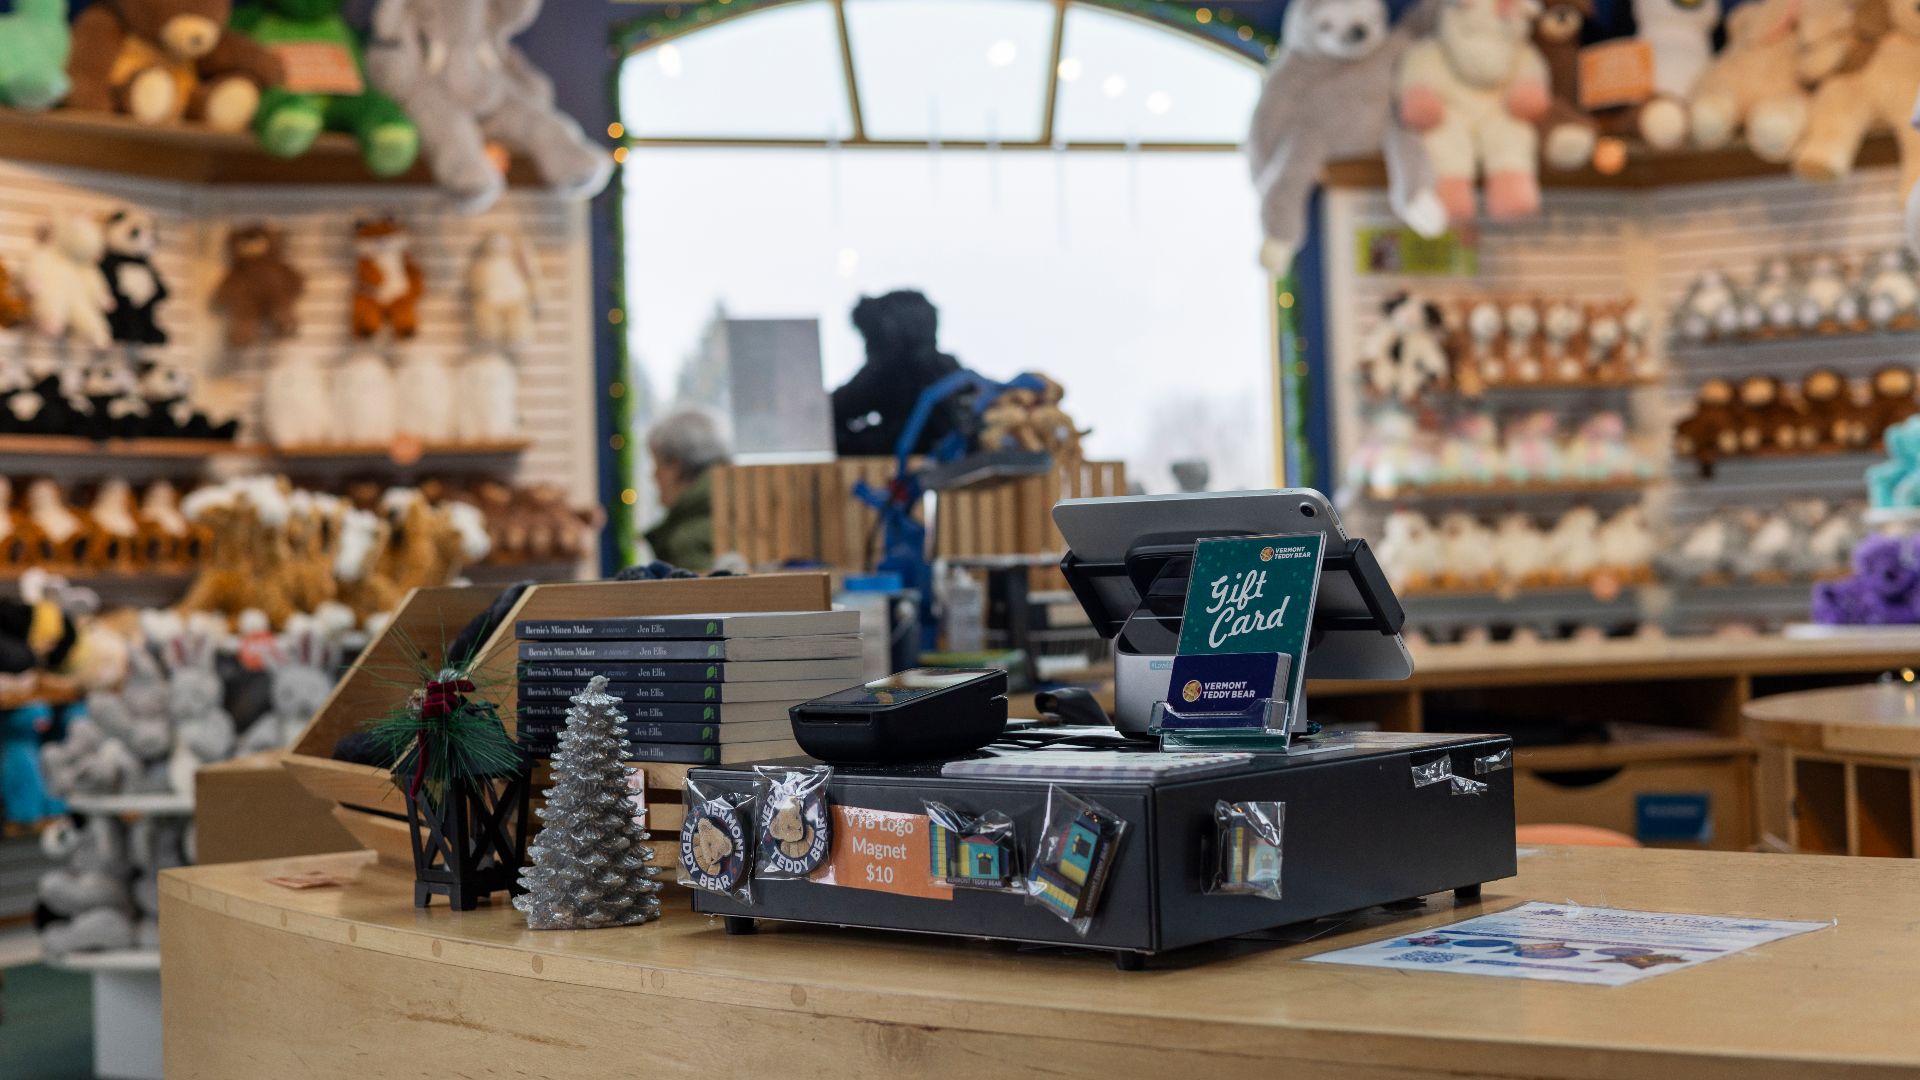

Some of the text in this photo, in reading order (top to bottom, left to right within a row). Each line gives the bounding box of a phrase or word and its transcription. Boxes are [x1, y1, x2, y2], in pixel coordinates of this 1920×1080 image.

[1206, 569, 1267, 613] Gift
[1208, 595, 1291, 649] Card
[525, 625, 550, 634] Bernie's
[550, 625, 572, 634] Mitten
[572, 625, 594, 634] Maker
[637, 624, 650, 633] Jen
[651, 624, 666, 633] Ellis
[528, 647, 552, 657] Bernie's
[553, 647, 574, 656] Mitten
[575, 647, 596, 656] Maker
[639, 647, 652, 656] Jen
[653, 647, 667, 656] Ellis
[527, 667, 551, 677] Bernie's
[552, 667, 573, 677] Mitten
[574, 668, 595, 677] Maker
[638, 668, 650, 677] Jen
[651, 667, 666, 677] Ellis
[1204, 681, 1248, 690] VERMONT
[552, 687, 573, 696] Mitten
[637, 688, 649, 697] Jen
[650, 688, 664, 697] Ellis
[1202, 690, 1256, 699] TEDDY BEAR
[636, 708, 648, 717] Jen
[649, 708, 663, 717] Ellis
[635, 727, 647, 736] Jen
[648, 727, 663, 736] Ellis
[636, 748, 649, 757] Jen
[649, 747, 664, 757] Ellis
[880, 816, 914, 837] Logo
[702, 802, 744, 862] VERMONT
[771, 816, 826, 874] TEDDY BEAR
[852, 836, 907, 860] Magnet
[682, 822, 731, 891] TEDDY BEAR
[866, 862, 894, 884] $10
